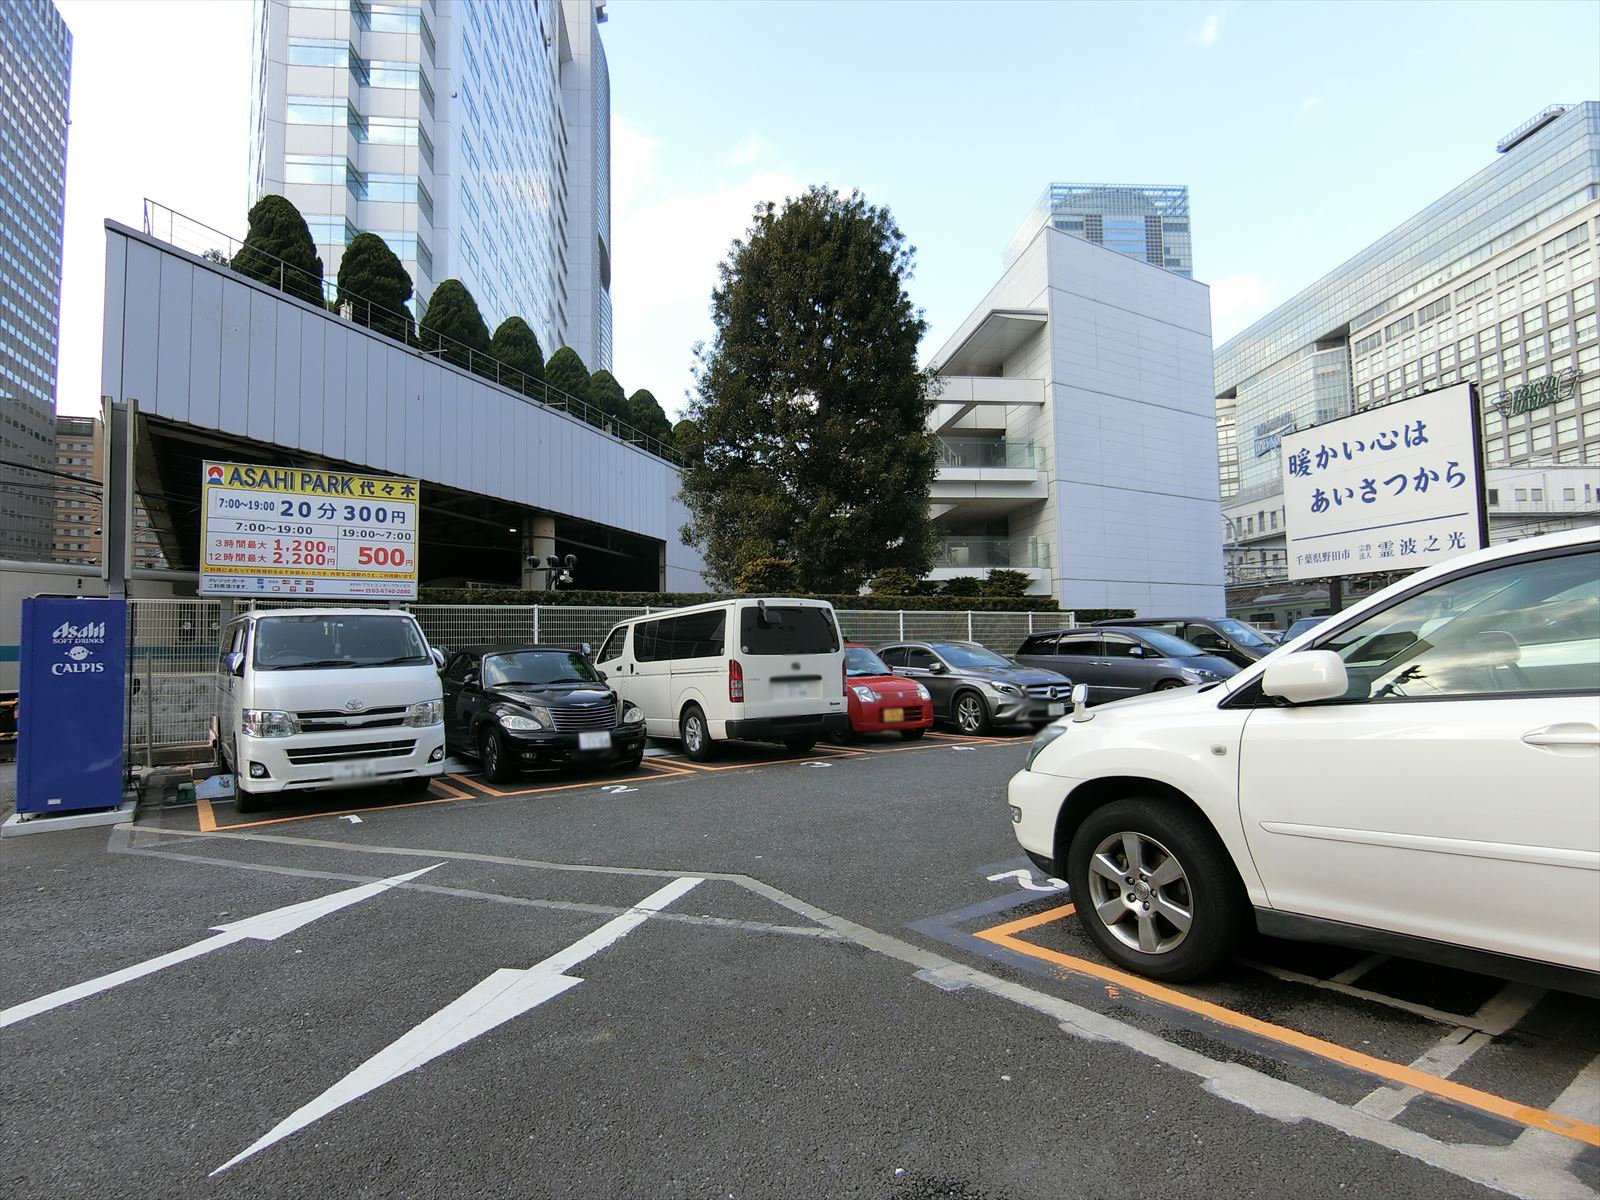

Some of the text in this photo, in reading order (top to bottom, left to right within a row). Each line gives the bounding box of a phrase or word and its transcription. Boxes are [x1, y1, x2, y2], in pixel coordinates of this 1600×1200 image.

[1513, 376, 1557, 401] TOKYU
[1288, 420, 1429, 478] 暖かい心は
[228, 467, 415, 498] ASAHI PARK 代々木
[1311, 461, 1466, 513] あいさつから
[280, 500, 337, 520] 20分
[343, 505, 406, 524] 300円
[215, 539, 336, 553] 3時間最大 1,200円
[1378, 531, 1466, 558] 霊波之光
[208, 552, 336, 566] 12時間最大 2,200円
[358, 547, 413, 567] 500円
[1296, 548, 1351, 566] 千葉県野田市
[52, 621, 105, 639] Asahi
[51, 662, 104, 676] CALPIS
[601, 785, 639, 794] 2
